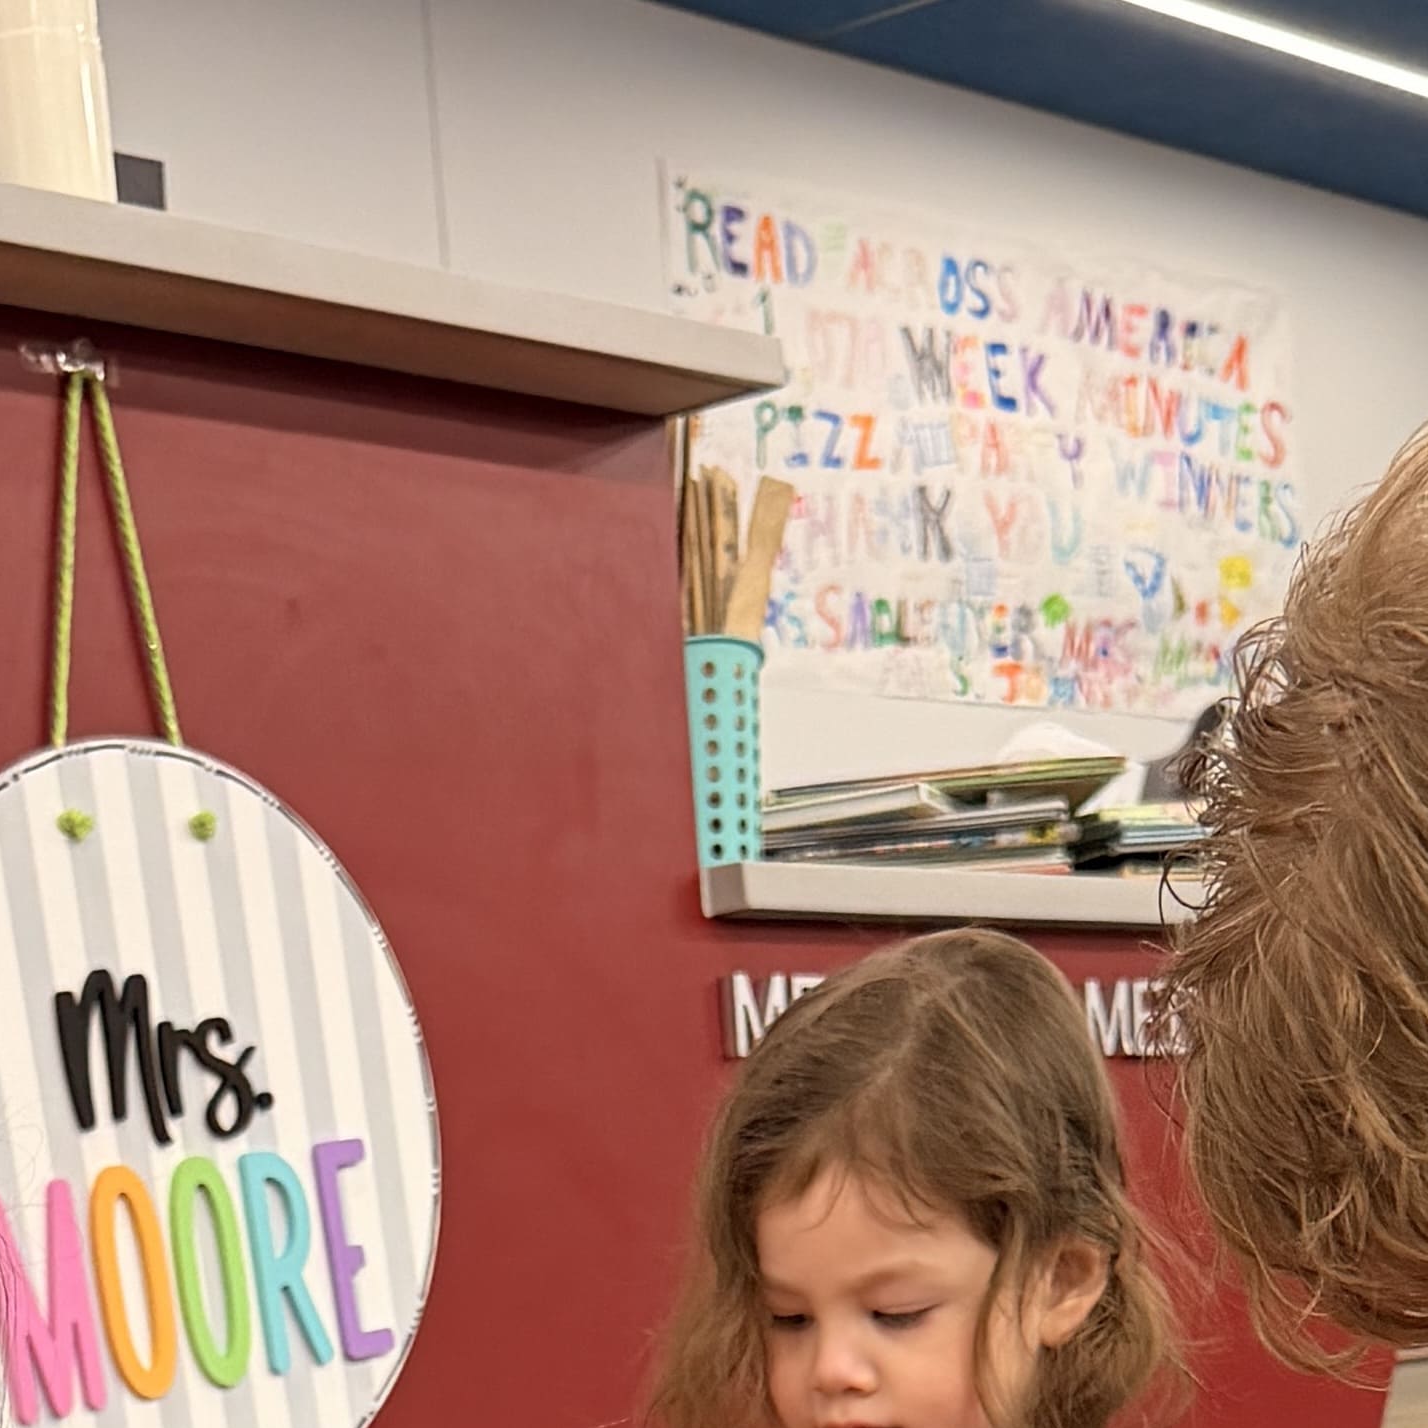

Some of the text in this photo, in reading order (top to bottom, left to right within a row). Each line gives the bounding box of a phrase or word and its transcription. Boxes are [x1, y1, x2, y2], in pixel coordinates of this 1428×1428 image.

[684, 188, 818, 288] READ
[1040, 276, 1251, 393] AMERICA
[899, 324, 1056, 420] WEEK
[1075, 366, 1292, 470] MINUTES
[1107, 436, 1300, 549] WINNERS
[53, 968, 274, 1146] Mrs.
